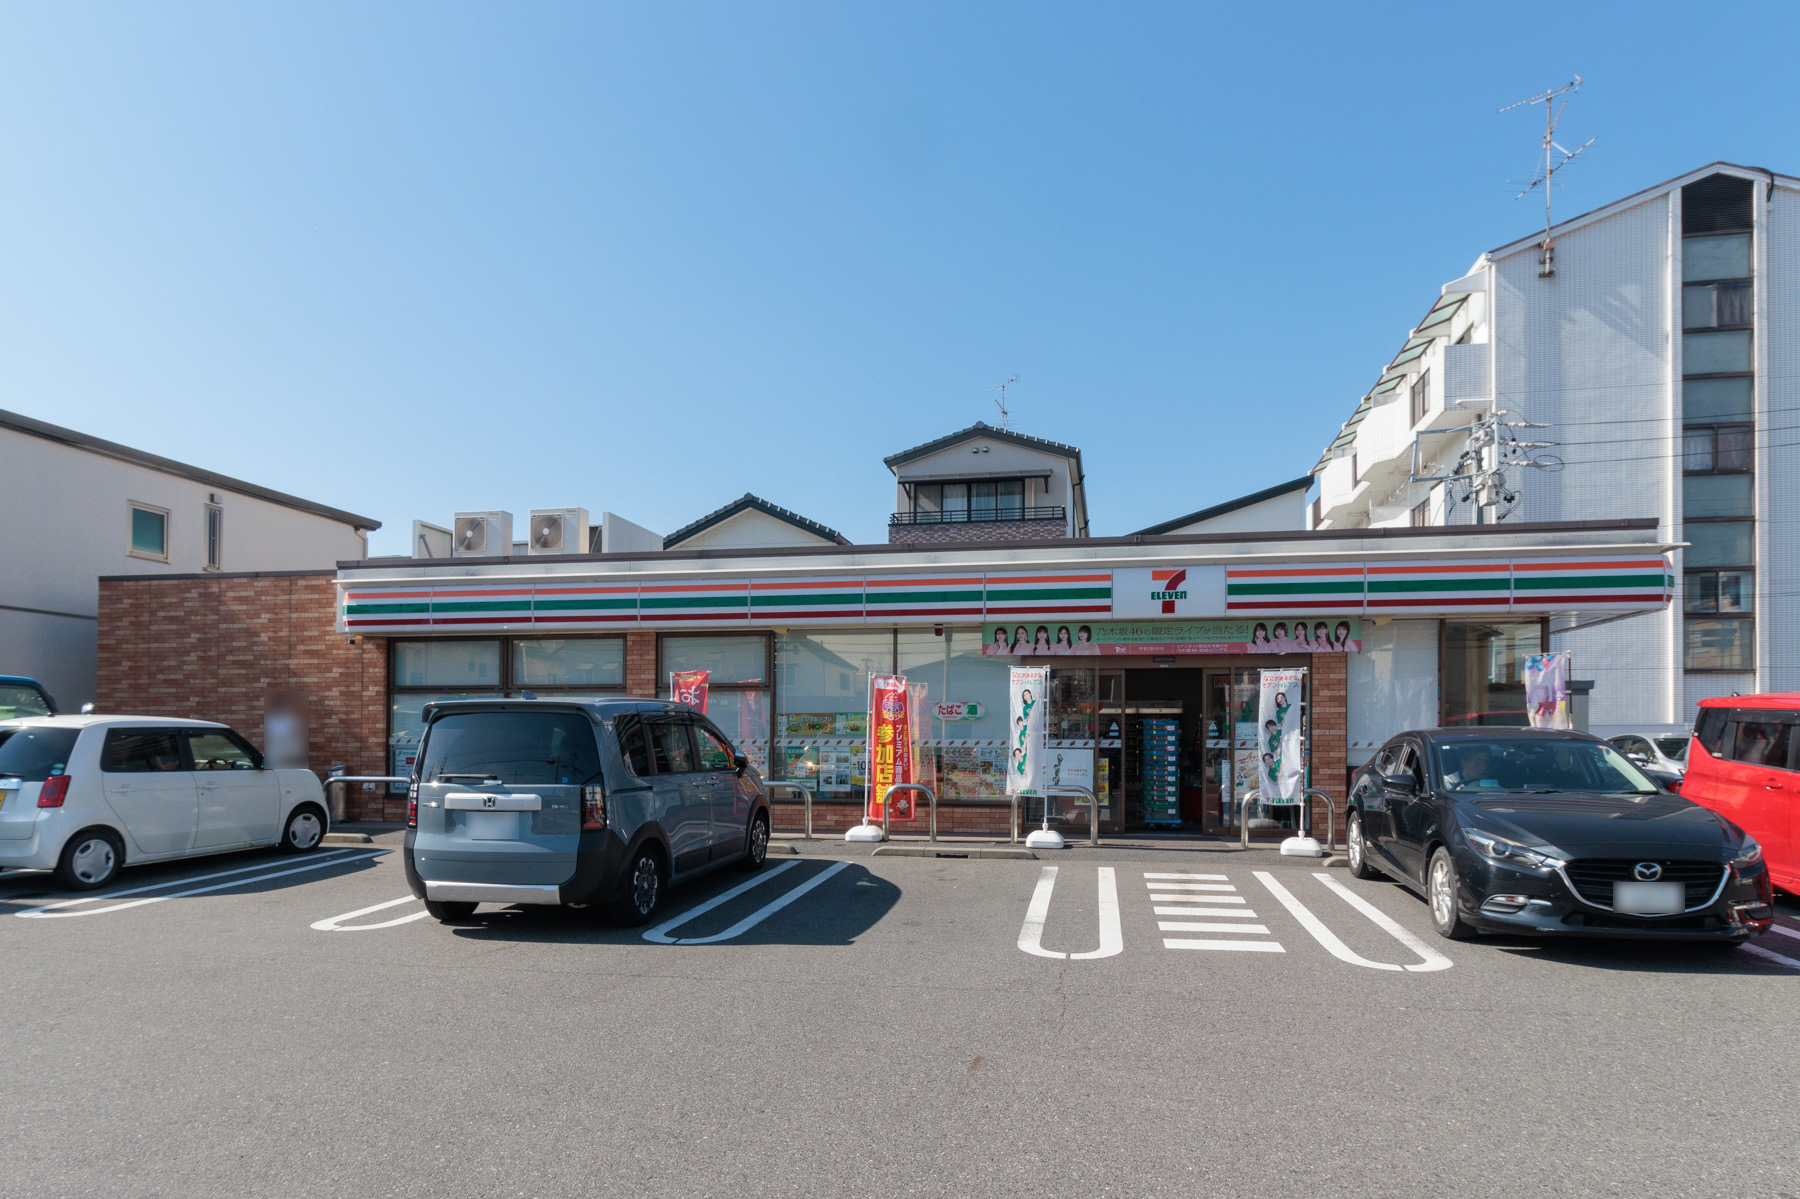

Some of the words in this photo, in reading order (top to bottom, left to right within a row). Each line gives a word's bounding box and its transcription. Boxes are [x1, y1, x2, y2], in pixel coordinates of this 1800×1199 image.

[938, 704, 962, 715] たばこ
[967, 704, 978, 716] 酒
[895, 724, 903, 786] プレミアム商品
